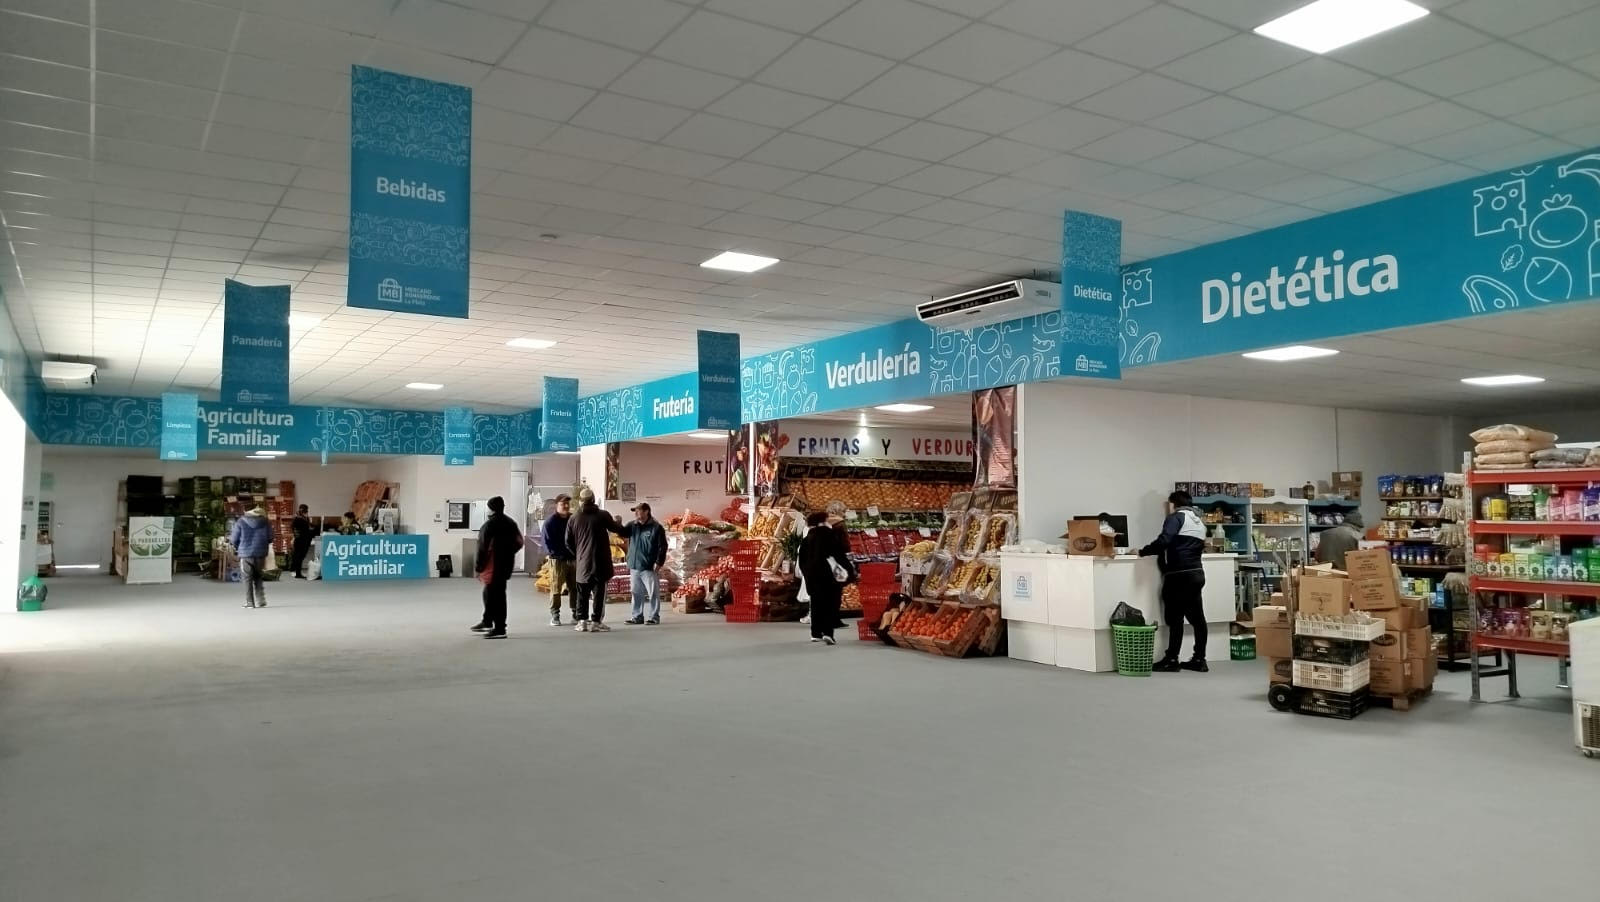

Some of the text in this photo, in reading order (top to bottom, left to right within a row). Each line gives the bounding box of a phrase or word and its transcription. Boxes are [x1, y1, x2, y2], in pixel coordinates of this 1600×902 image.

[376, 177, 446, 202] Bebidas
[382, 288, 399, 299] MB
[1074, 284, 1112, 301] Dietética
[1202, 249, 1399, 324] Dietética
[232, 335, 282, 348] Panadería
[825, 342, 920, 389] Verdulería
[653, 389, 694, 420] Frutería
[197, 407, 294, 427] Agricultura
[207, 428, 280, 446] Familiar
[798, 437, 973, 456] FRUTAS Y VERDUR
[683, 460, 725, 474] FRUT
[325, 539, 417, 560] Agricultura
[338, 559, 405, 576] Familiar
